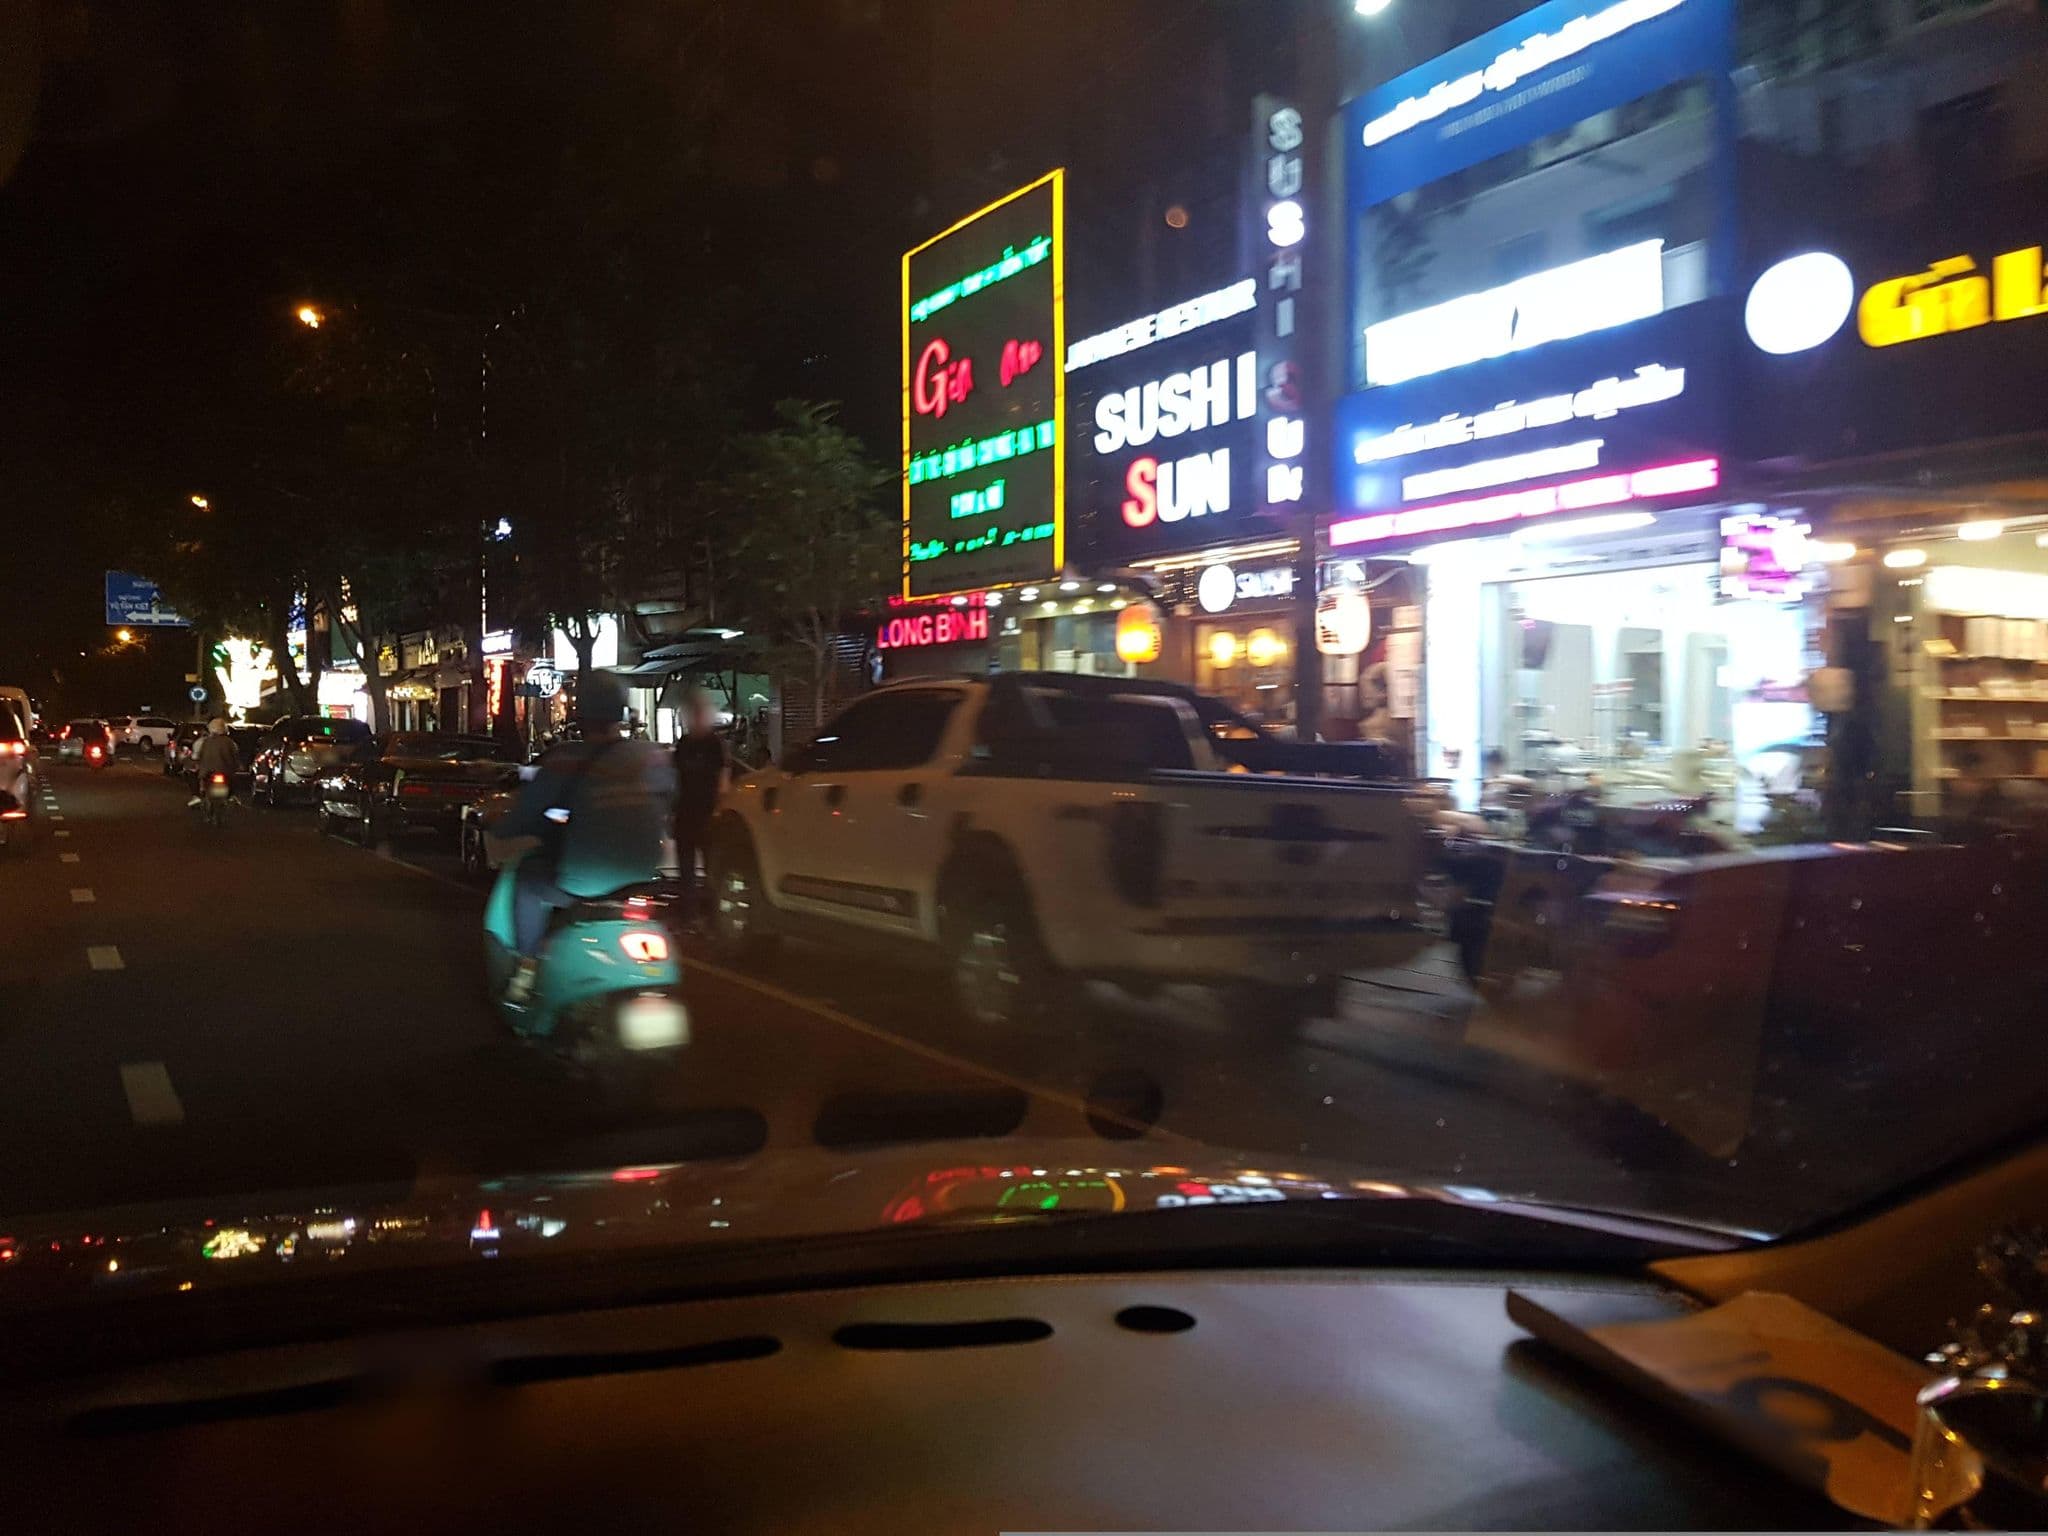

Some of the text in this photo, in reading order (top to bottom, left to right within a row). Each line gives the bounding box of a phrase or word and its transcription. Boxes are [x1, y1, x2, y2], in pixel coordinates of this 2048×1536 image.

[1266, 107, 1304, 338] SUSHI
[1093, 350, 1257, 455] SUSHI
[1121, 447, 1231, 528] SUN
[877, 614, 934, 649] LONG
